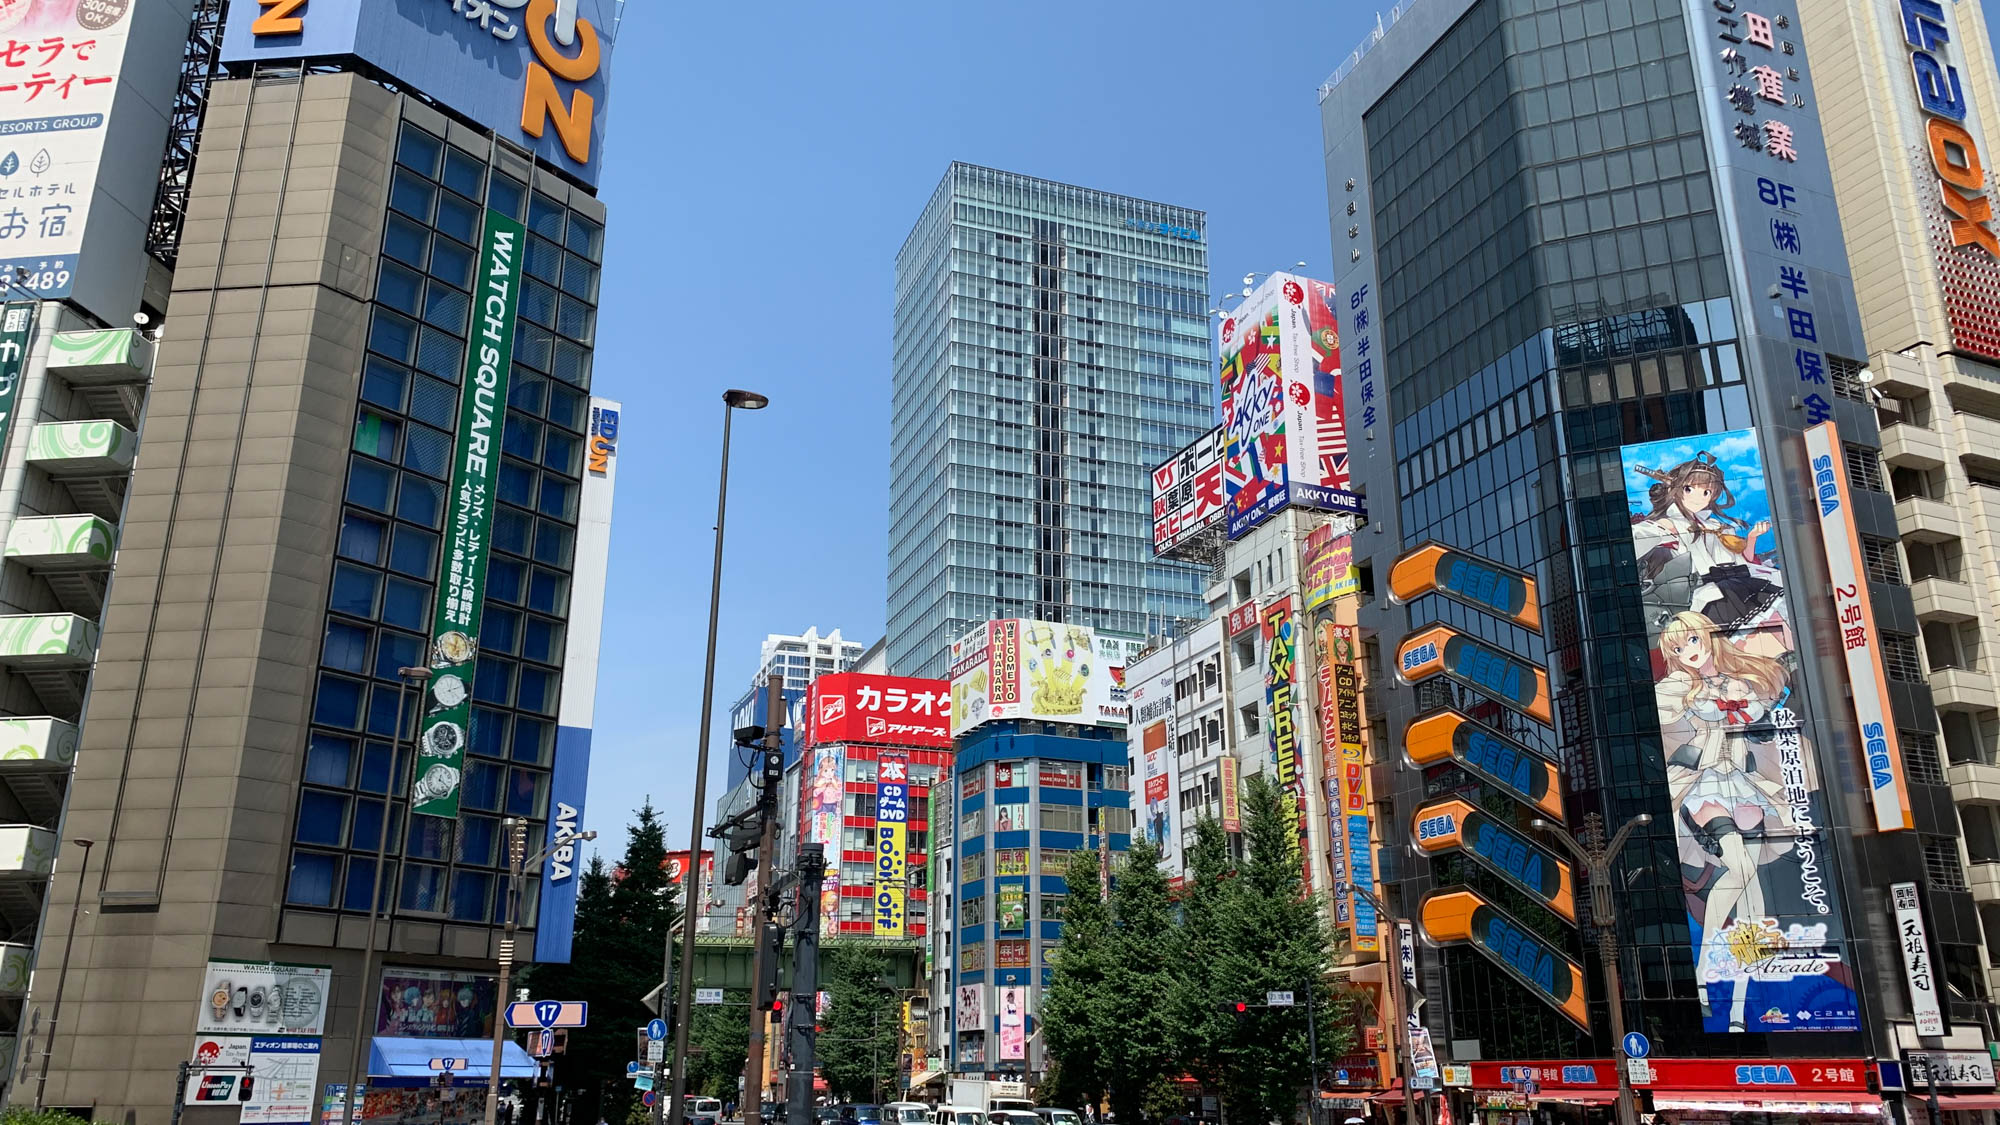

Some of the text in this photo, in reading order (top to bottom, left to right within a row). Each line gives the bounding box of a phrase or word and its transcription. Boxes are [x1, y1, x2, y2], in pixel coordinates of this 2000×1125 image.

[52, 116, 98, 130] GROUP
[1757, 177, 1796, 209] 8F
[0, 203, 72, 240] お宿
[1351, 284, 1368, 310] 8F
[465, 230, 514, 478] WATCH SQUARE
[1253, 410, 1271, 433] ONE
[588, 408, 619, 473] EDION
[1154, 480, 1193, 520] 秋葉原
[1295, 487, 1358, 508] AKKY ONE
[1812, 454, 1839, 519] SEGA
[1155, 510, 1194, 545] ホビー
[1447, 559, 1511, 612] SEGA
[1231, 605, 1256, 633] 免税
[1835, 583, 1867, 652] 2号館
[1005, 621, 1017, 702] WELCOME TO
[1268, 608, 1290, 685] TAX
[1402, 640, 1438, 672] SEGA
[952, 649, 989, 678] TAKARADA
[993, 626, 1004, 702] AKIHABARA
[1455, 643, 1521, 702] SEGA
[1338, 676, 1353, 687] CD
[888, 723, 947, 737] アドアーズ
[1273, 685, 1294, 786] FREE
[880, 761, 906, 780] 本
[1465, 731, 1532, 797] SEGA
[1862, 721, 1893, 792] SEGA
[883, 786, 902, 797] CD
[1346, 763, 1364, 811] DVD
[879, 797, 905, 809] ゲーム
[879, 809, 905, 821] DVD
[1419, 815, 1456, 841] SEGA
[1475, 823, 1542, 900] SEGA
[243, 964, 270, 972] WATCH
[1484, 917, 1554, 994] SEGA
[1744, 956, 1824, 974] Arcade
[1902, 918, 1930, 991] 元祖寿司
[539, 1004, 558, 1021] 17
[542, 1033, 550, 1048] 17
[444, 1059, 452, 1068] 17
[1562, 1065, 1597, 1083] SEGA
[1735, 1064, 1855, 1085] SEGA 2号館
[201, 1080, 233, 1090] UnionPay
